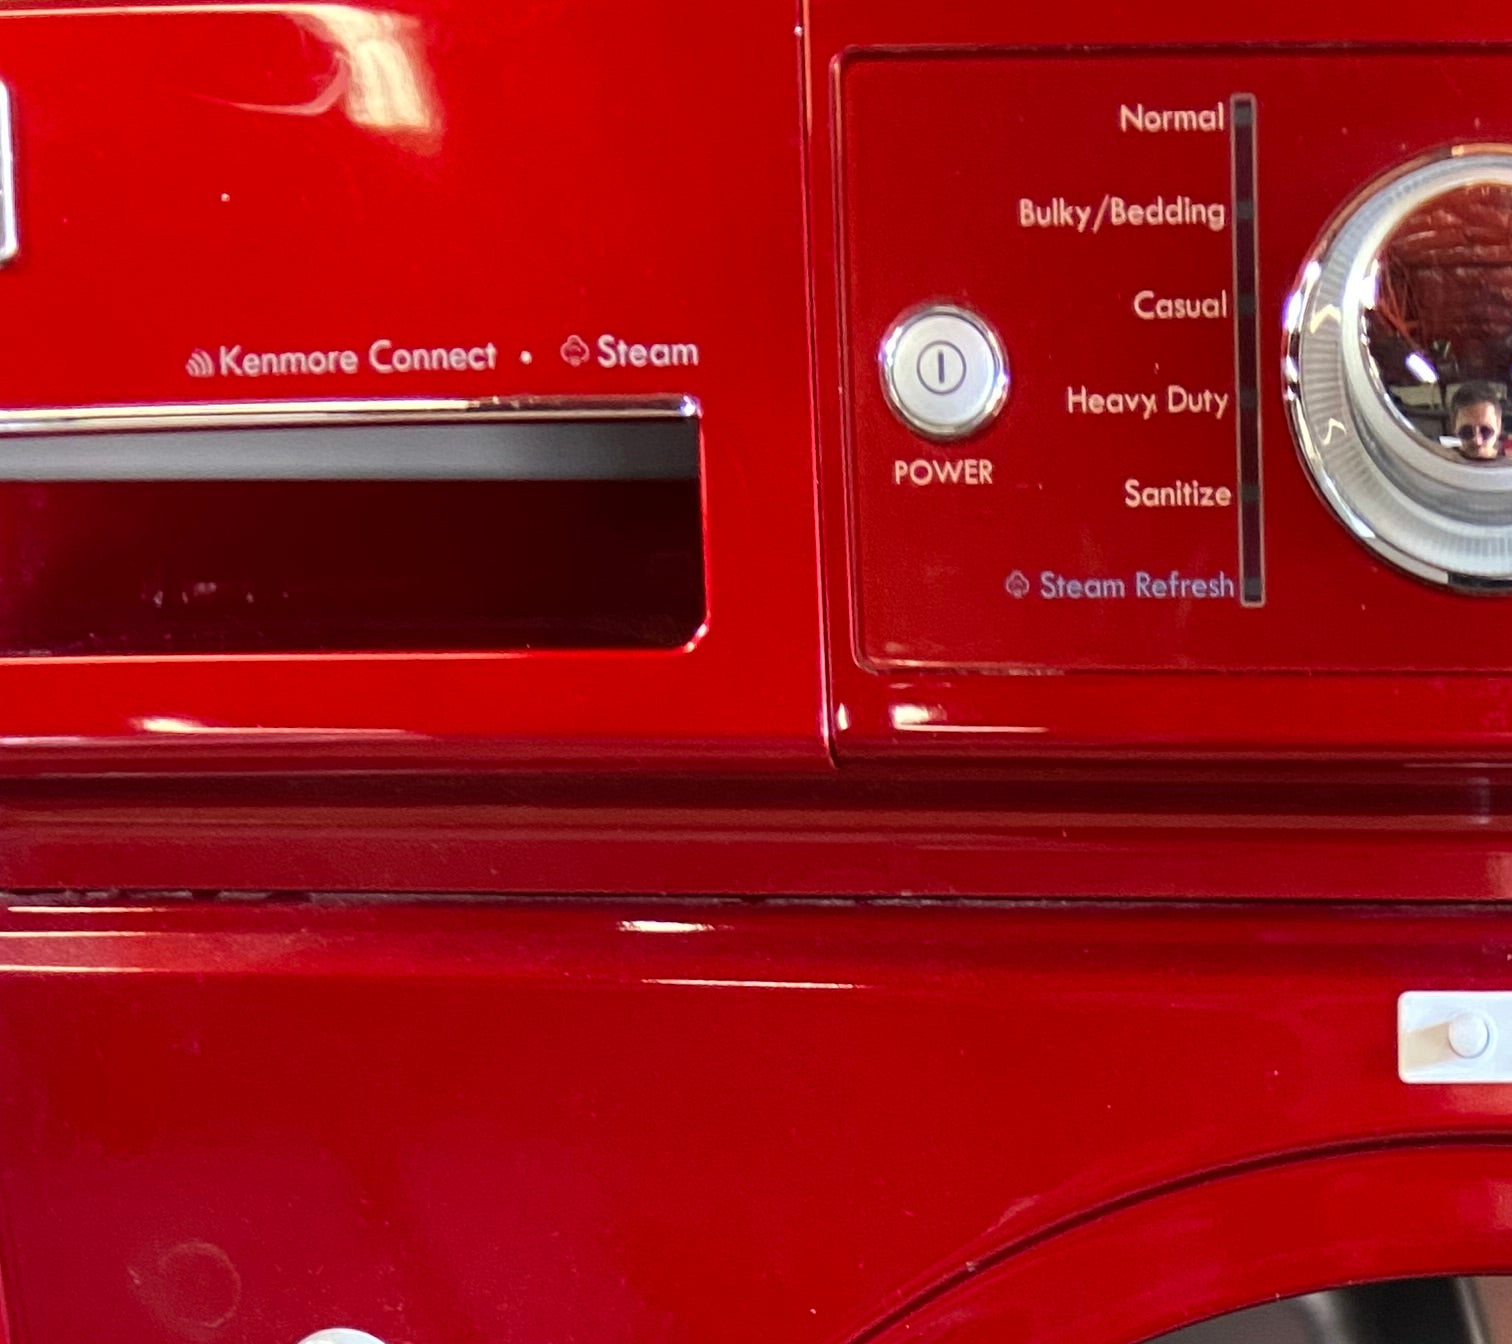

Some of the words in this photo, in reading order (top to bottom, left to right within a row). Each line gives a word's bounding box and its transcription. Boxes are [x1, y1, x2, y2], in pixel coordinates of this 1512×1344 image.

[1120, 103, 1225, 132] Normal
[1019, 194, 1226, 233] Bulky/Bedding
[1133, 290, 1228, 320] Casual
[219, 346, 358, 377] Kenmore
[368, 339, 497, 374] Connect
[597, 334, 699, 369] Steam
[1067, 386, 1158, 416] Heavy
[1168, 387, 1229, 418] Duty
[894, 460, 993, 486] POWER
[1124, 480, 1232, 508] Sanitize
[1040, 571, 1126, 599] Steam
[1135, 571, 1234, 598] Refresh
